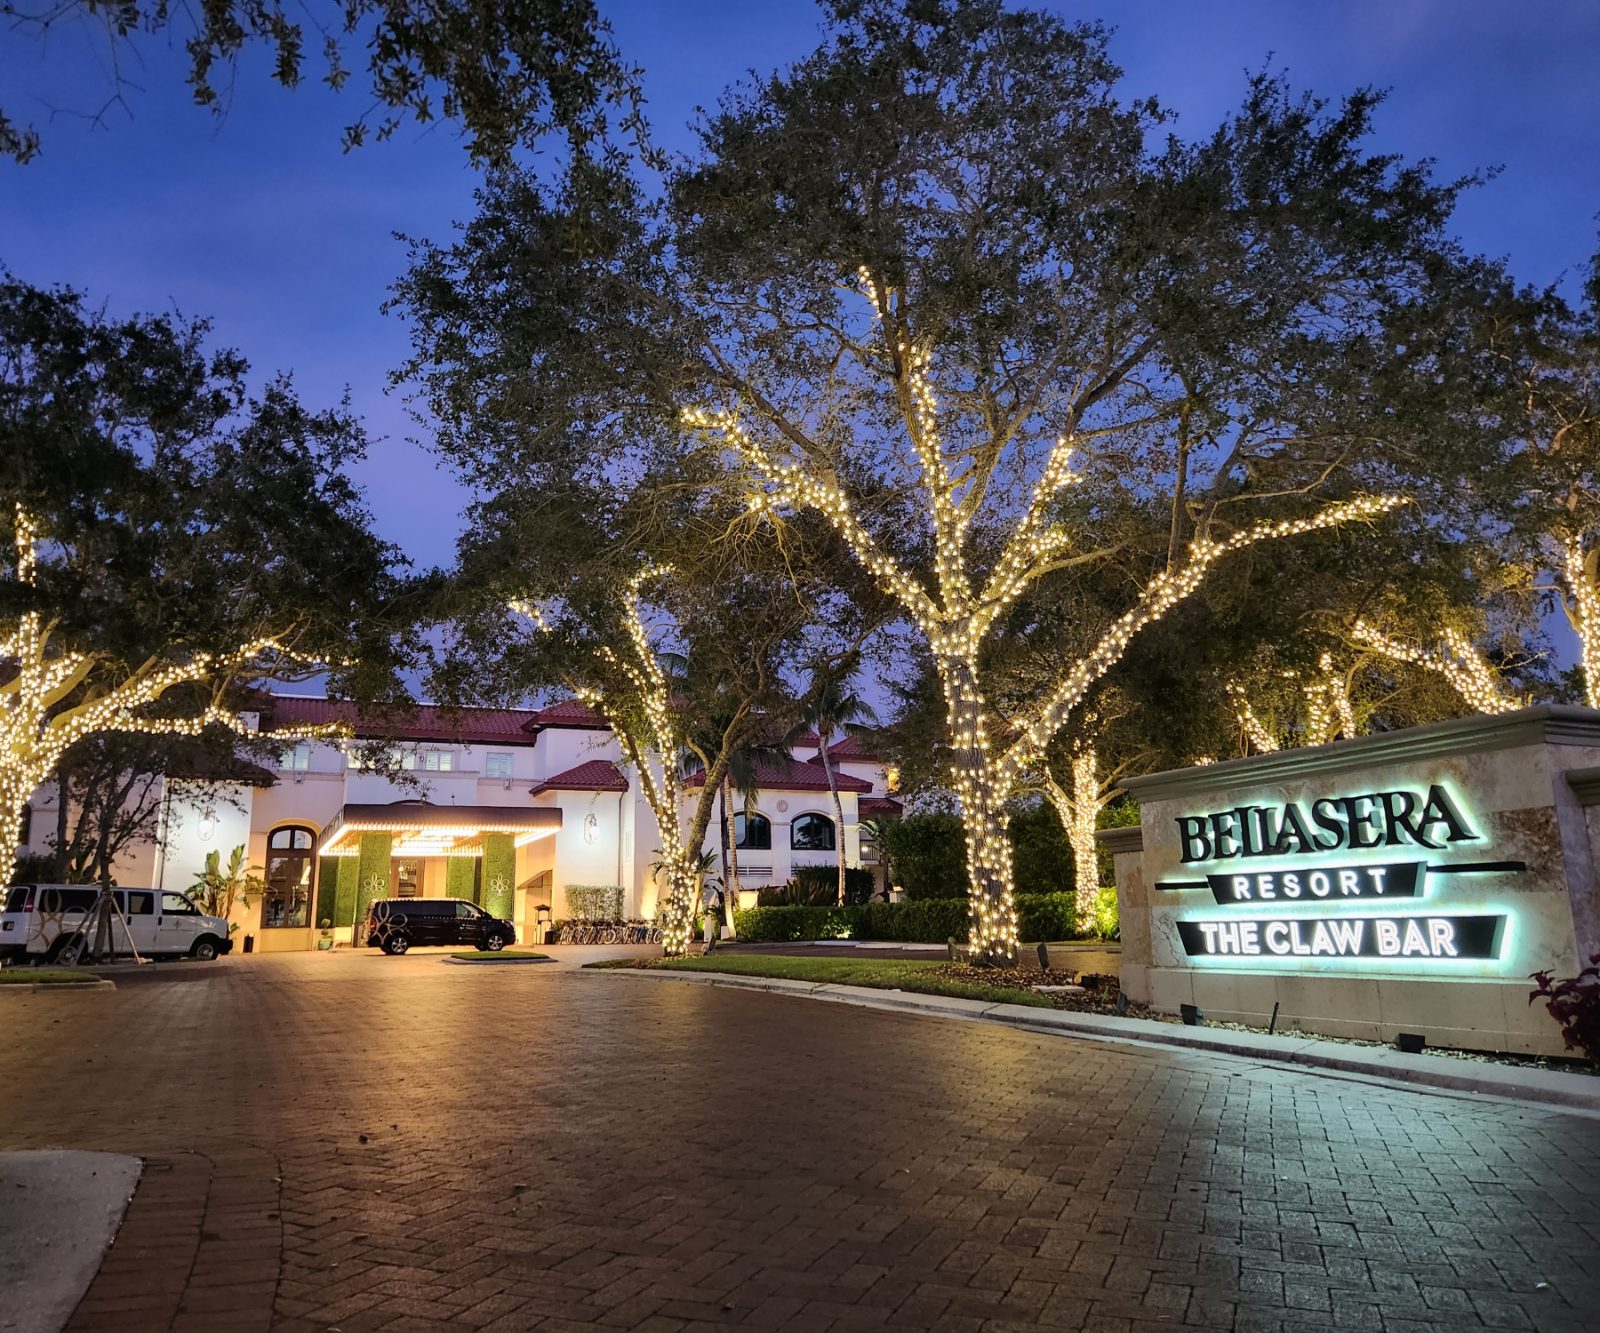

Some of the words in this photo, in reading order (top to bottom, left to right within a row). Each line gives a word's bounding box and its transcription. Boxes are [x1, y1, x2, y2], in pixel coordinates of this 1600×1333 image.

[1175, 785, 1480, 863] BELLASERA
[1234, 868, 1387, 900] RESORT
[1201, 922, 1262, 954] THE
[1265, 919, 1363, 956] CLAW
[1377, 918, 1458, 957] BAR
